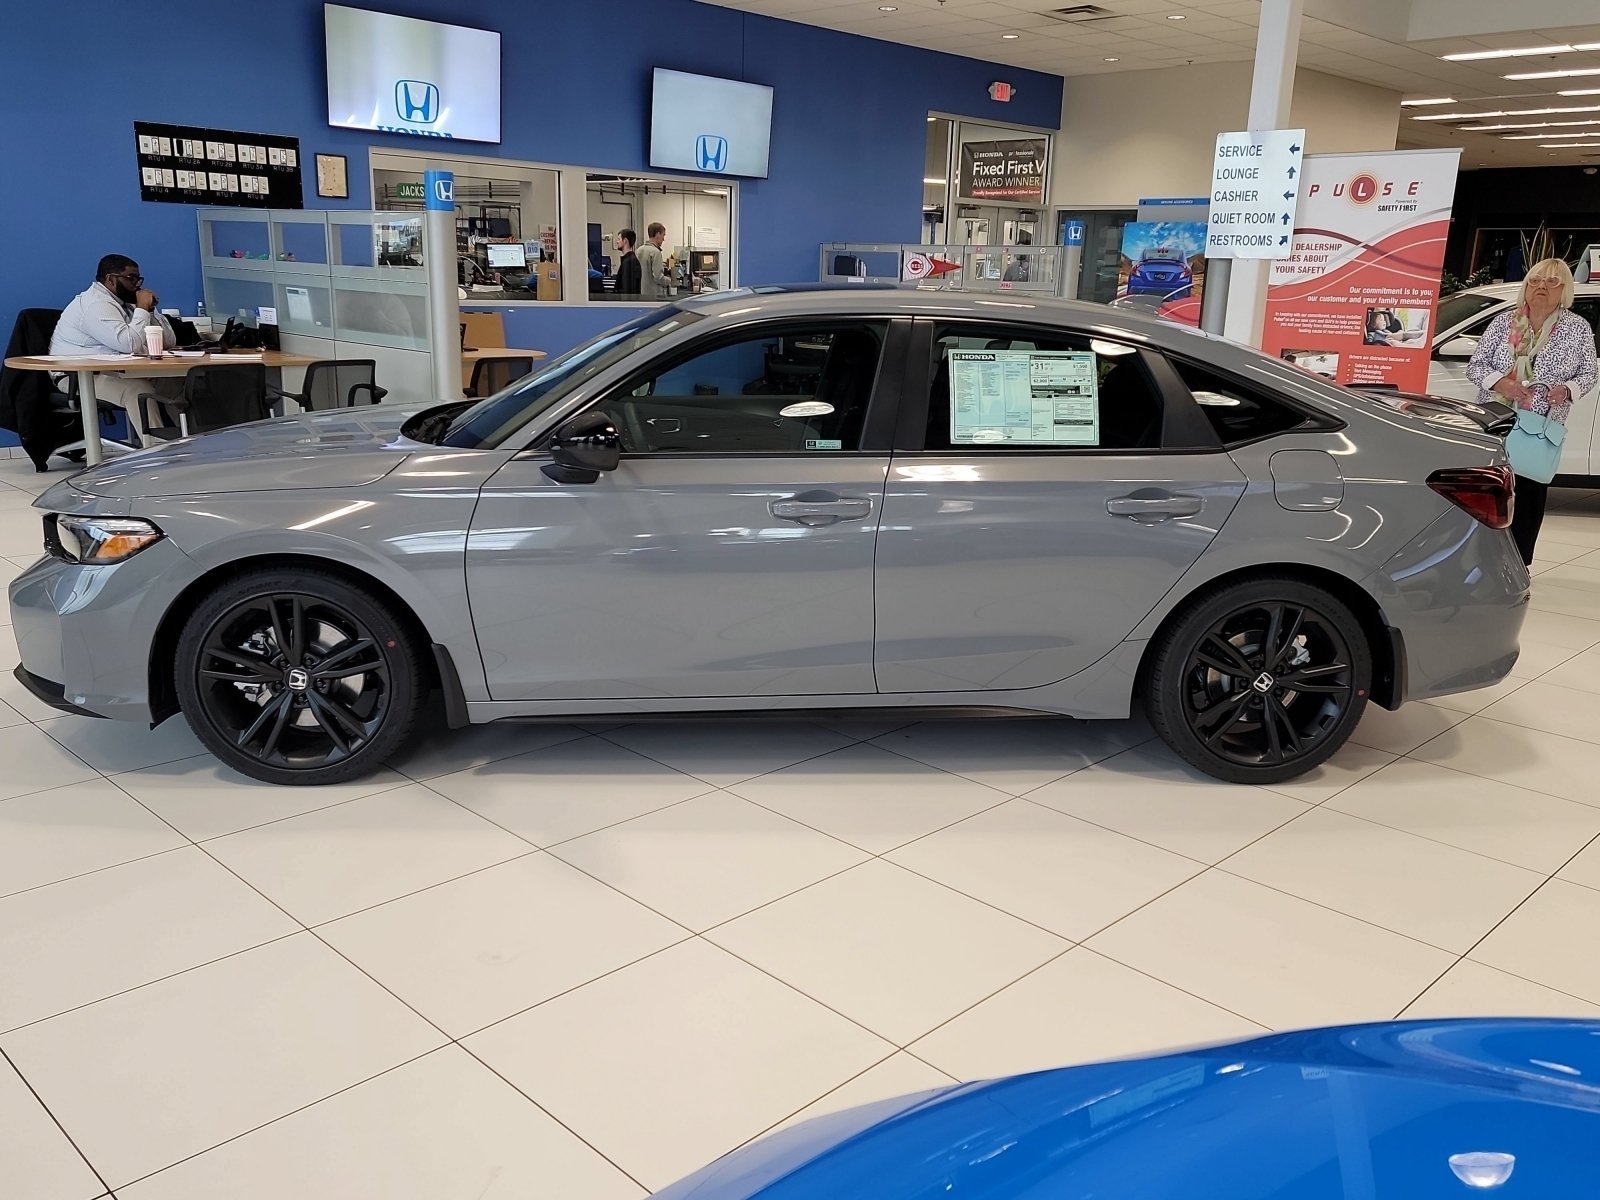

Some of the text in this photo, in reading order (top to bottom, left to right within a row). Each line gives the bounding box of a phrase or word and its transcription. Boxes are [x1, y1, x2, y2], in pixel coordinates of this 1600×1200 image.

[1218, 144, 1263, 158] SERVICE
[972, 160, 1004, 176] Fixed
[1007, 160, 1034, 174] First
[1216, 168, 1260, 180] LOUNGE
[972, 176, 1040, 187] AWARD WINNER
[1214, 190, 1258, 202] CASHIER
[1212, 212, 1276, 224] QUIET ROOM
[1210, 234, 1272, 246] RESTROOMS
[1303, 254, 1328, 262] ABOUT
[1276, 266, 1326, 274] YOUR SAFETY
[1362, 287, 1402, 295] commitment
[1378, 297, 1398, 306] family
